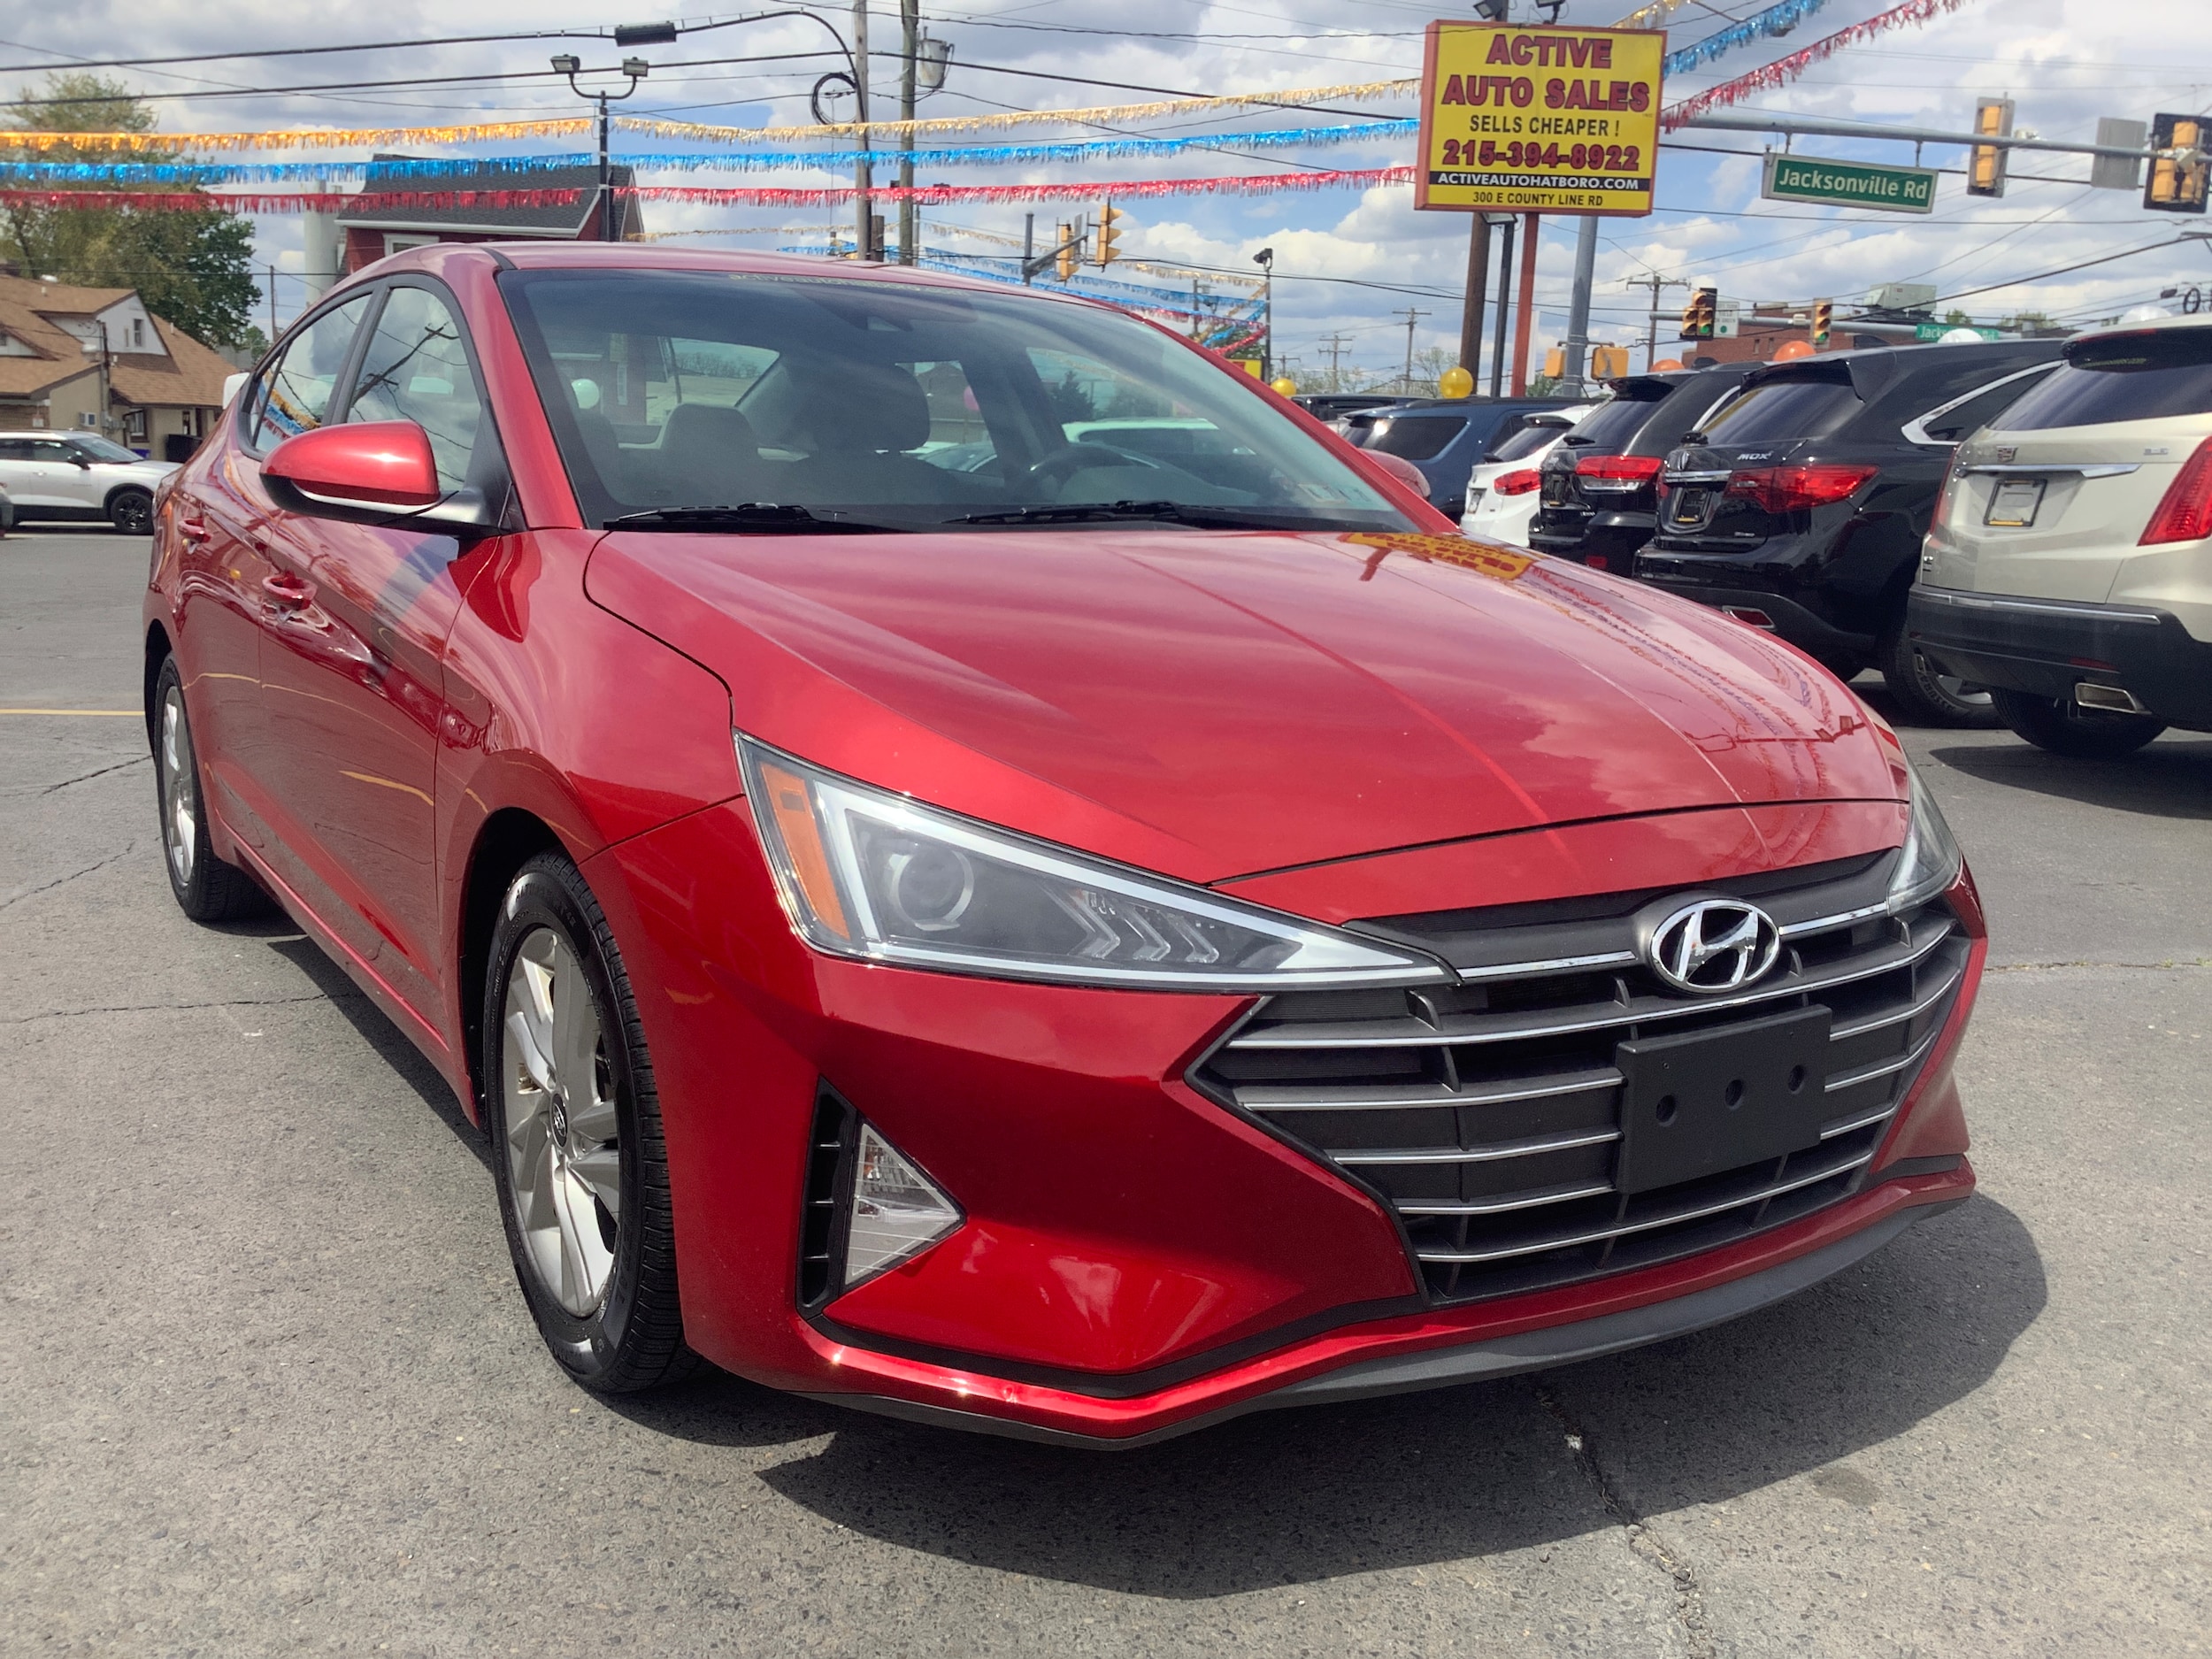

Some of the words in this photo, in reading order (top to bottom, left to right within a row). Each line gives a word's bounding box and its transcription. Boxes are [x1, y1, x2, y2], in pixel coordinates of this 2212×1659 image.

[1486, 34, 1613, 69] ACTIVE
[1441, 74, 1534, 107] AUTO
[1544, 78, 1650, 112] SALES
[1470, 114, 1522, 133] SELLS
[1529, 117, 1609, 136] CHEAPER
[1441, 139, 1640, 172] 215-394-8922
[1438, 173, 1639, 190] ACTIVEAUTOHATBORO.COM
[1778, 167, 1899, 196] Jacksonville
[1903, 180, 1928, 199] Rd
[1472, 191, 1493, 203] 300
[1496, 192, 1503, 204] E
[1507, 192, 1555, 204] COUNTY
[1558, 194, 1584, 205] LINE
[1588, 195, 1603, 206] RD
